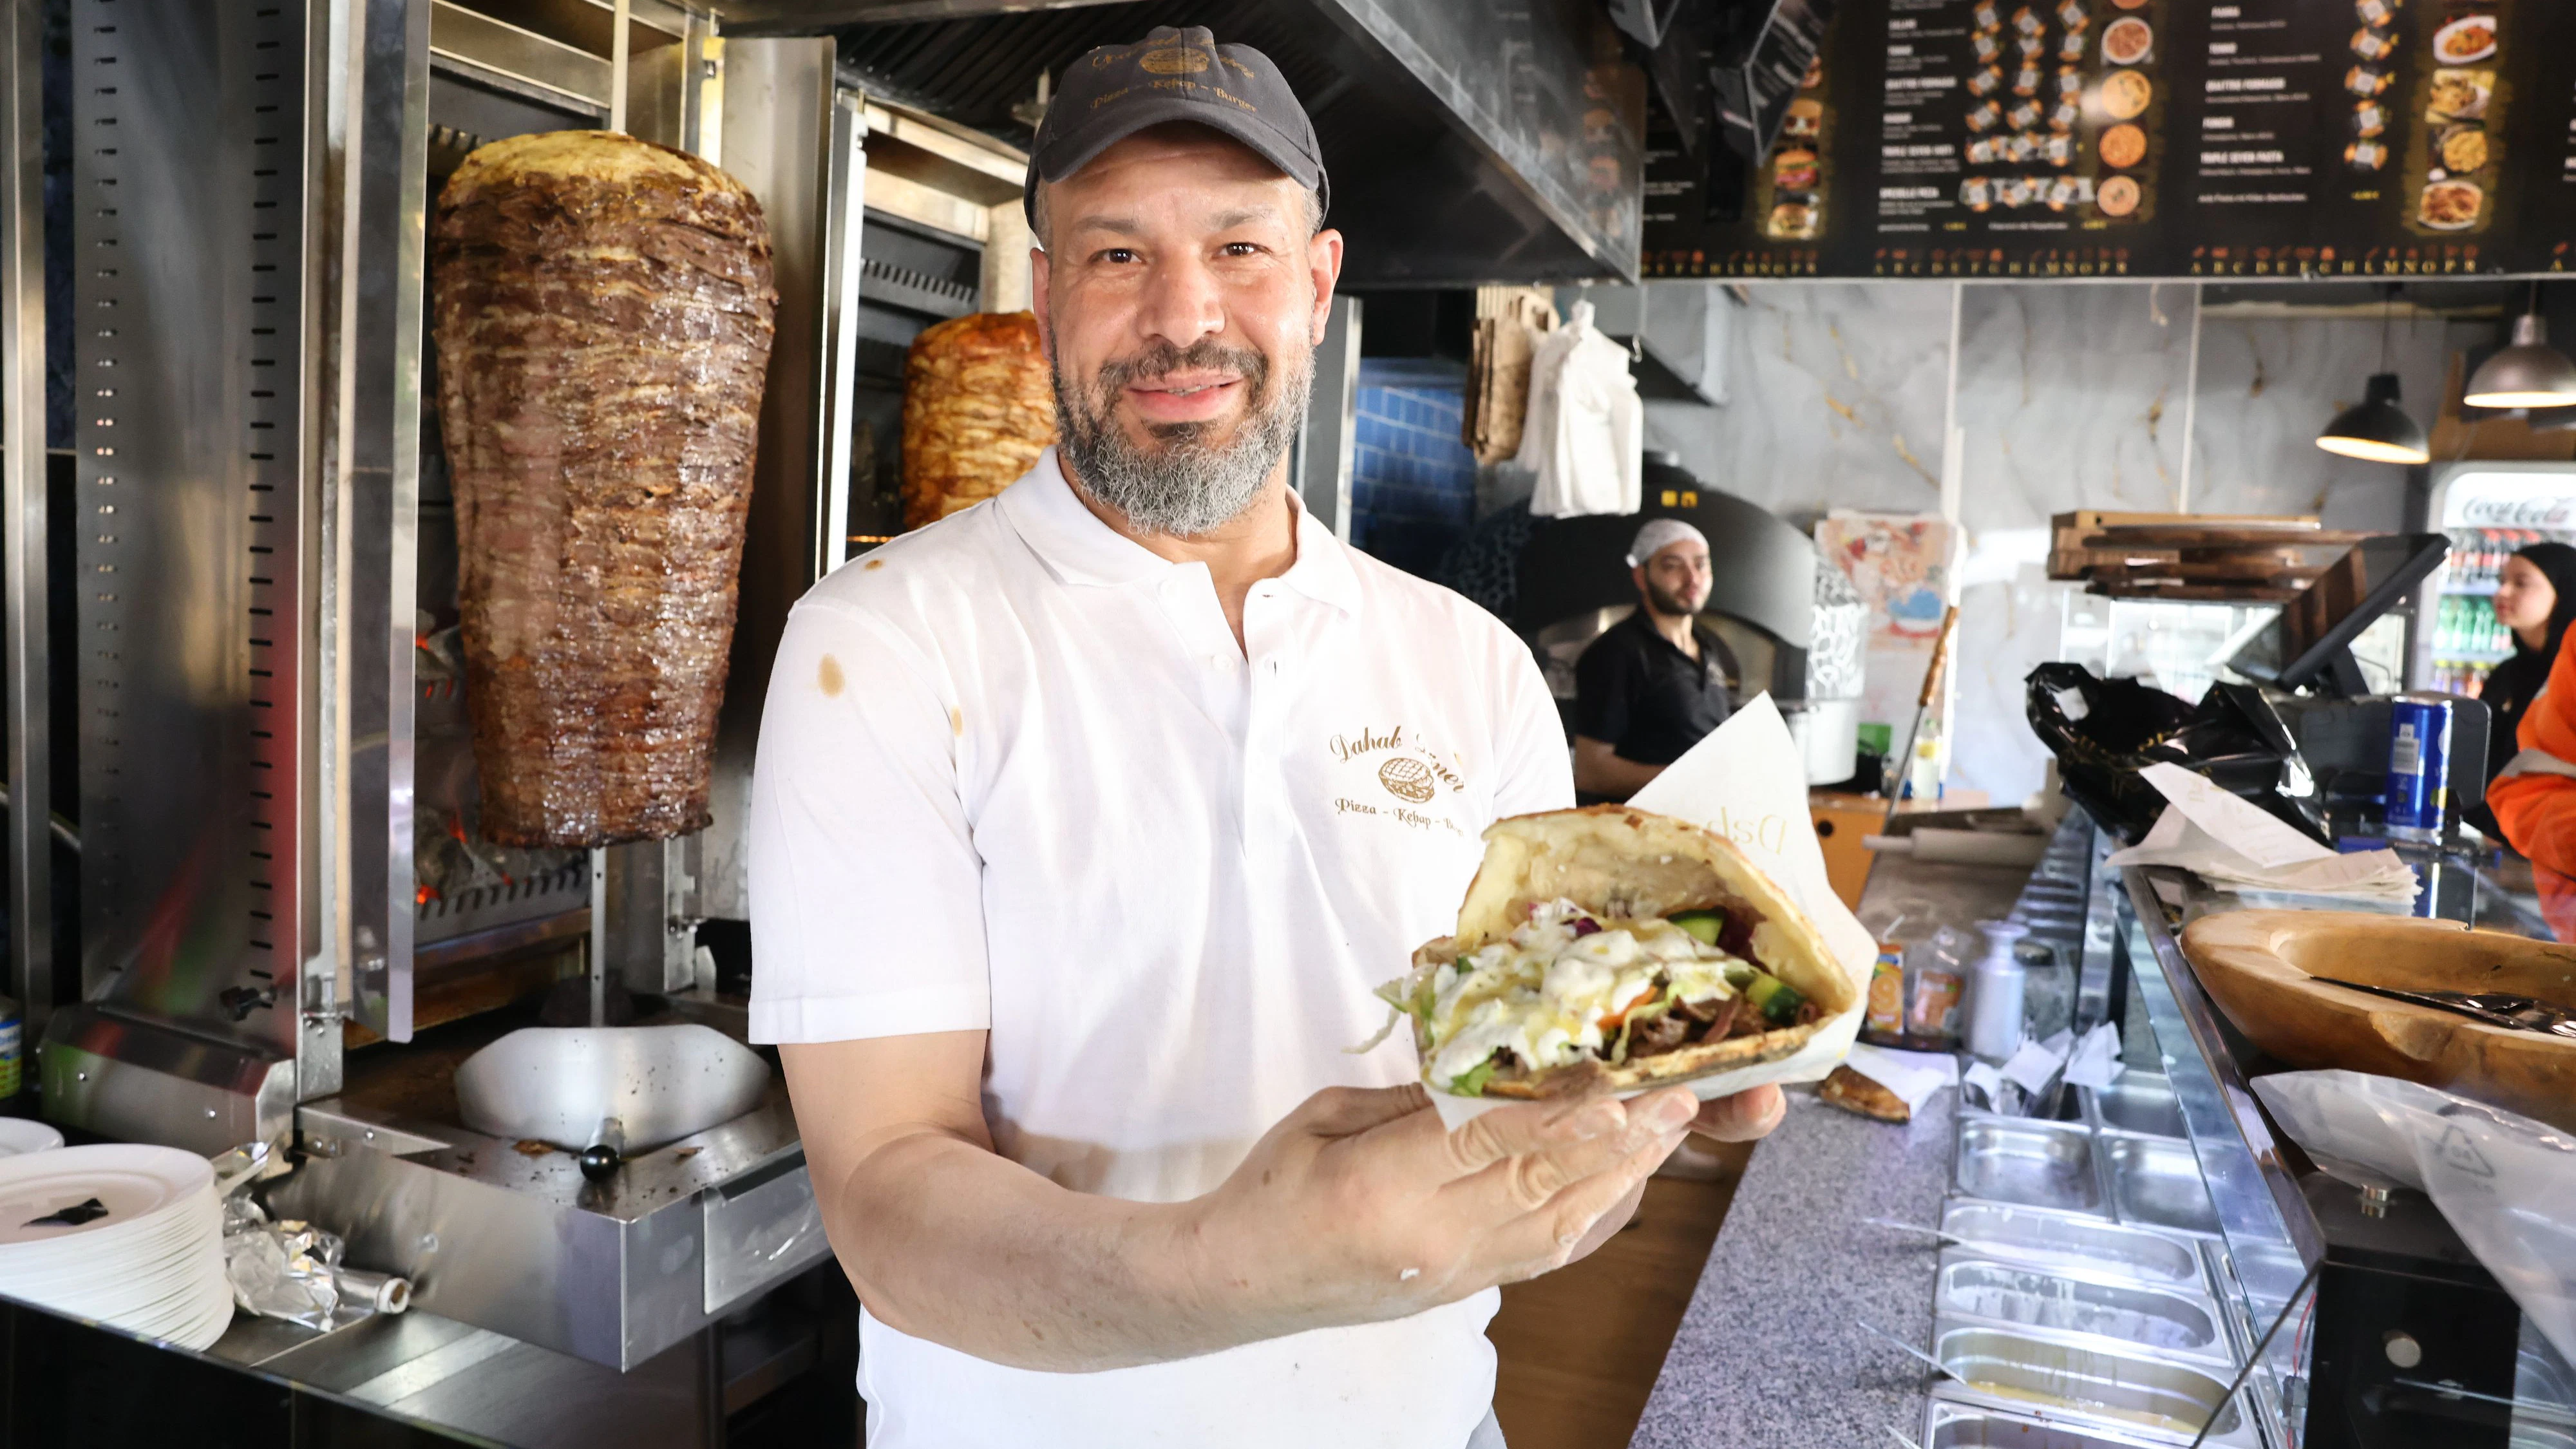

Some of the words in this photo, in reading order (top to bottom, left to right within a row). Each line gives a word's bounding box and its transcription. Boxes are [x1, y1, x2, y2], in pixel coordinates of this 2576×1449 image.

[1213, 86, 1256, 113] Burger
[1335, 798, 1376, 815] Pizza
[1393, 808, 1431, 828] Kebap
